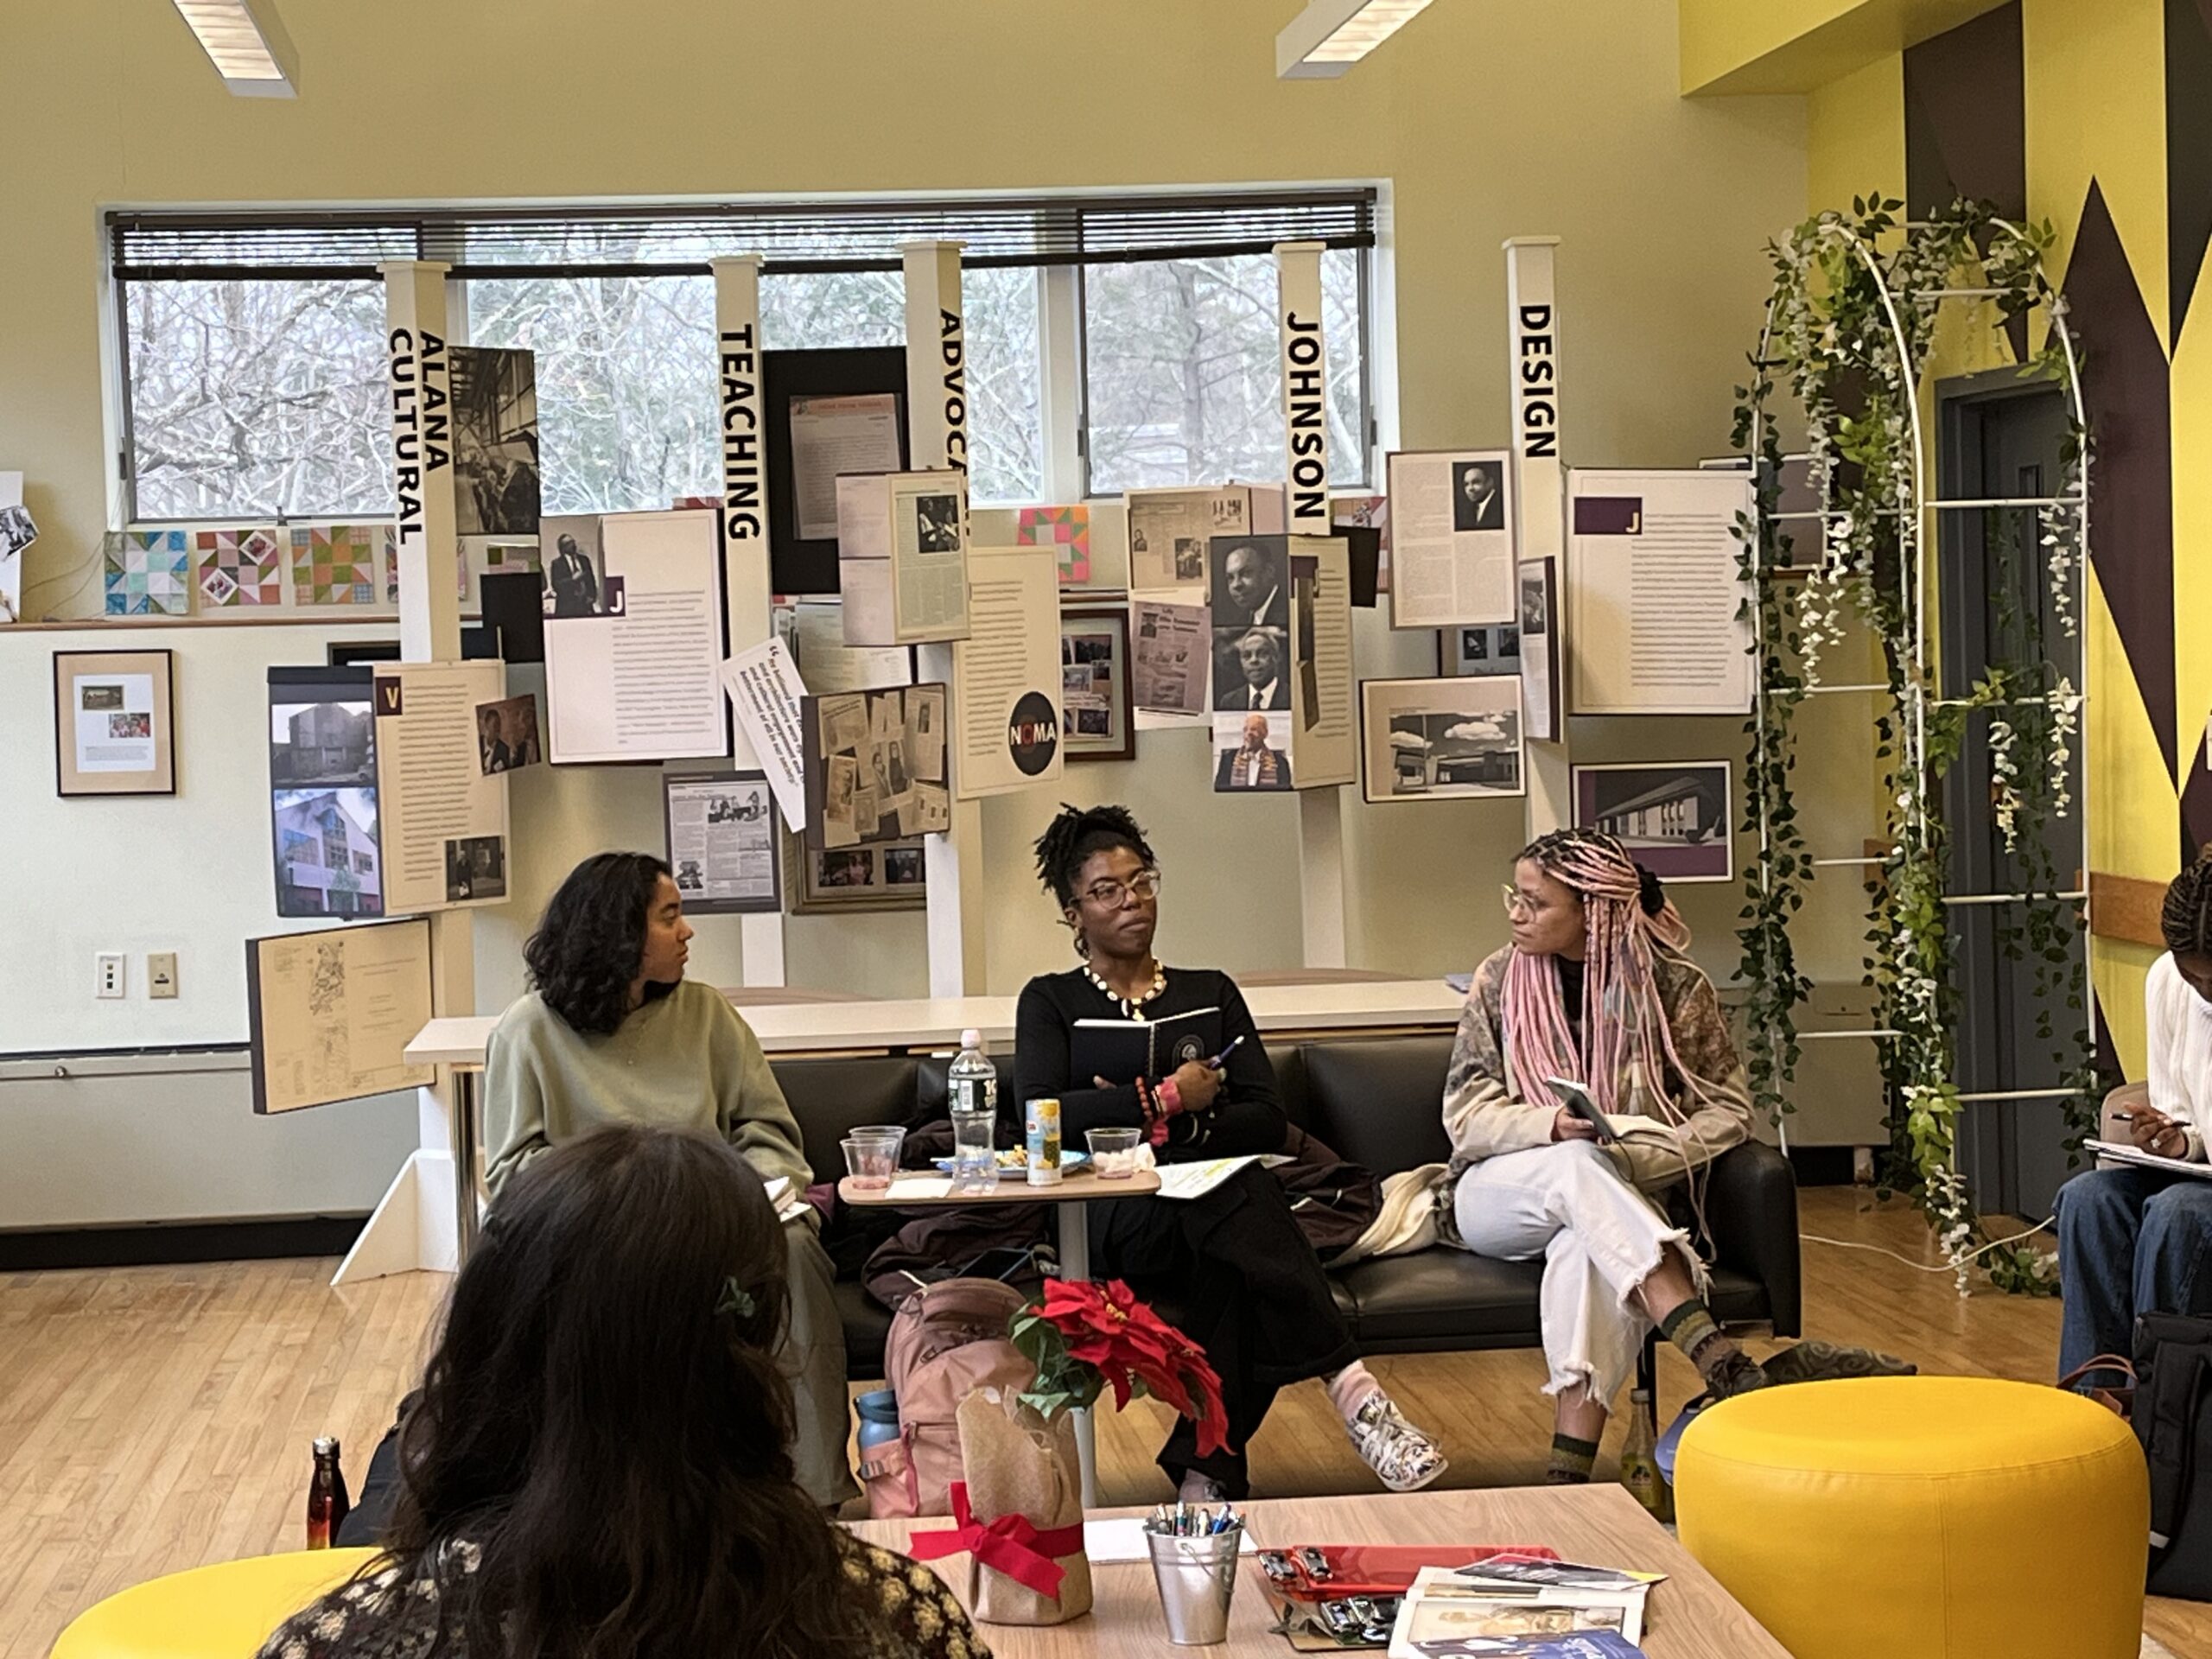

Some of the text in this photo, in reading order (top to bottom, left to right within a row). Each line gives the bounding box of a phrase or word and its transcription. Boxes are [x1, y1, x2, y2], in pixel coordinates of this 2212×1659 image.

[390, 328, 422, 544] CULTURAL
[420, 330, 449, 472] ALANA
[721, 324, 760, 539] TEACHING
[1287, 312, 1325, 518] JOHNSON
[1520, 305, 1556, 458] DESIGN
[609, 590, 623, 613] J
[385, 687, 398, 709] V
